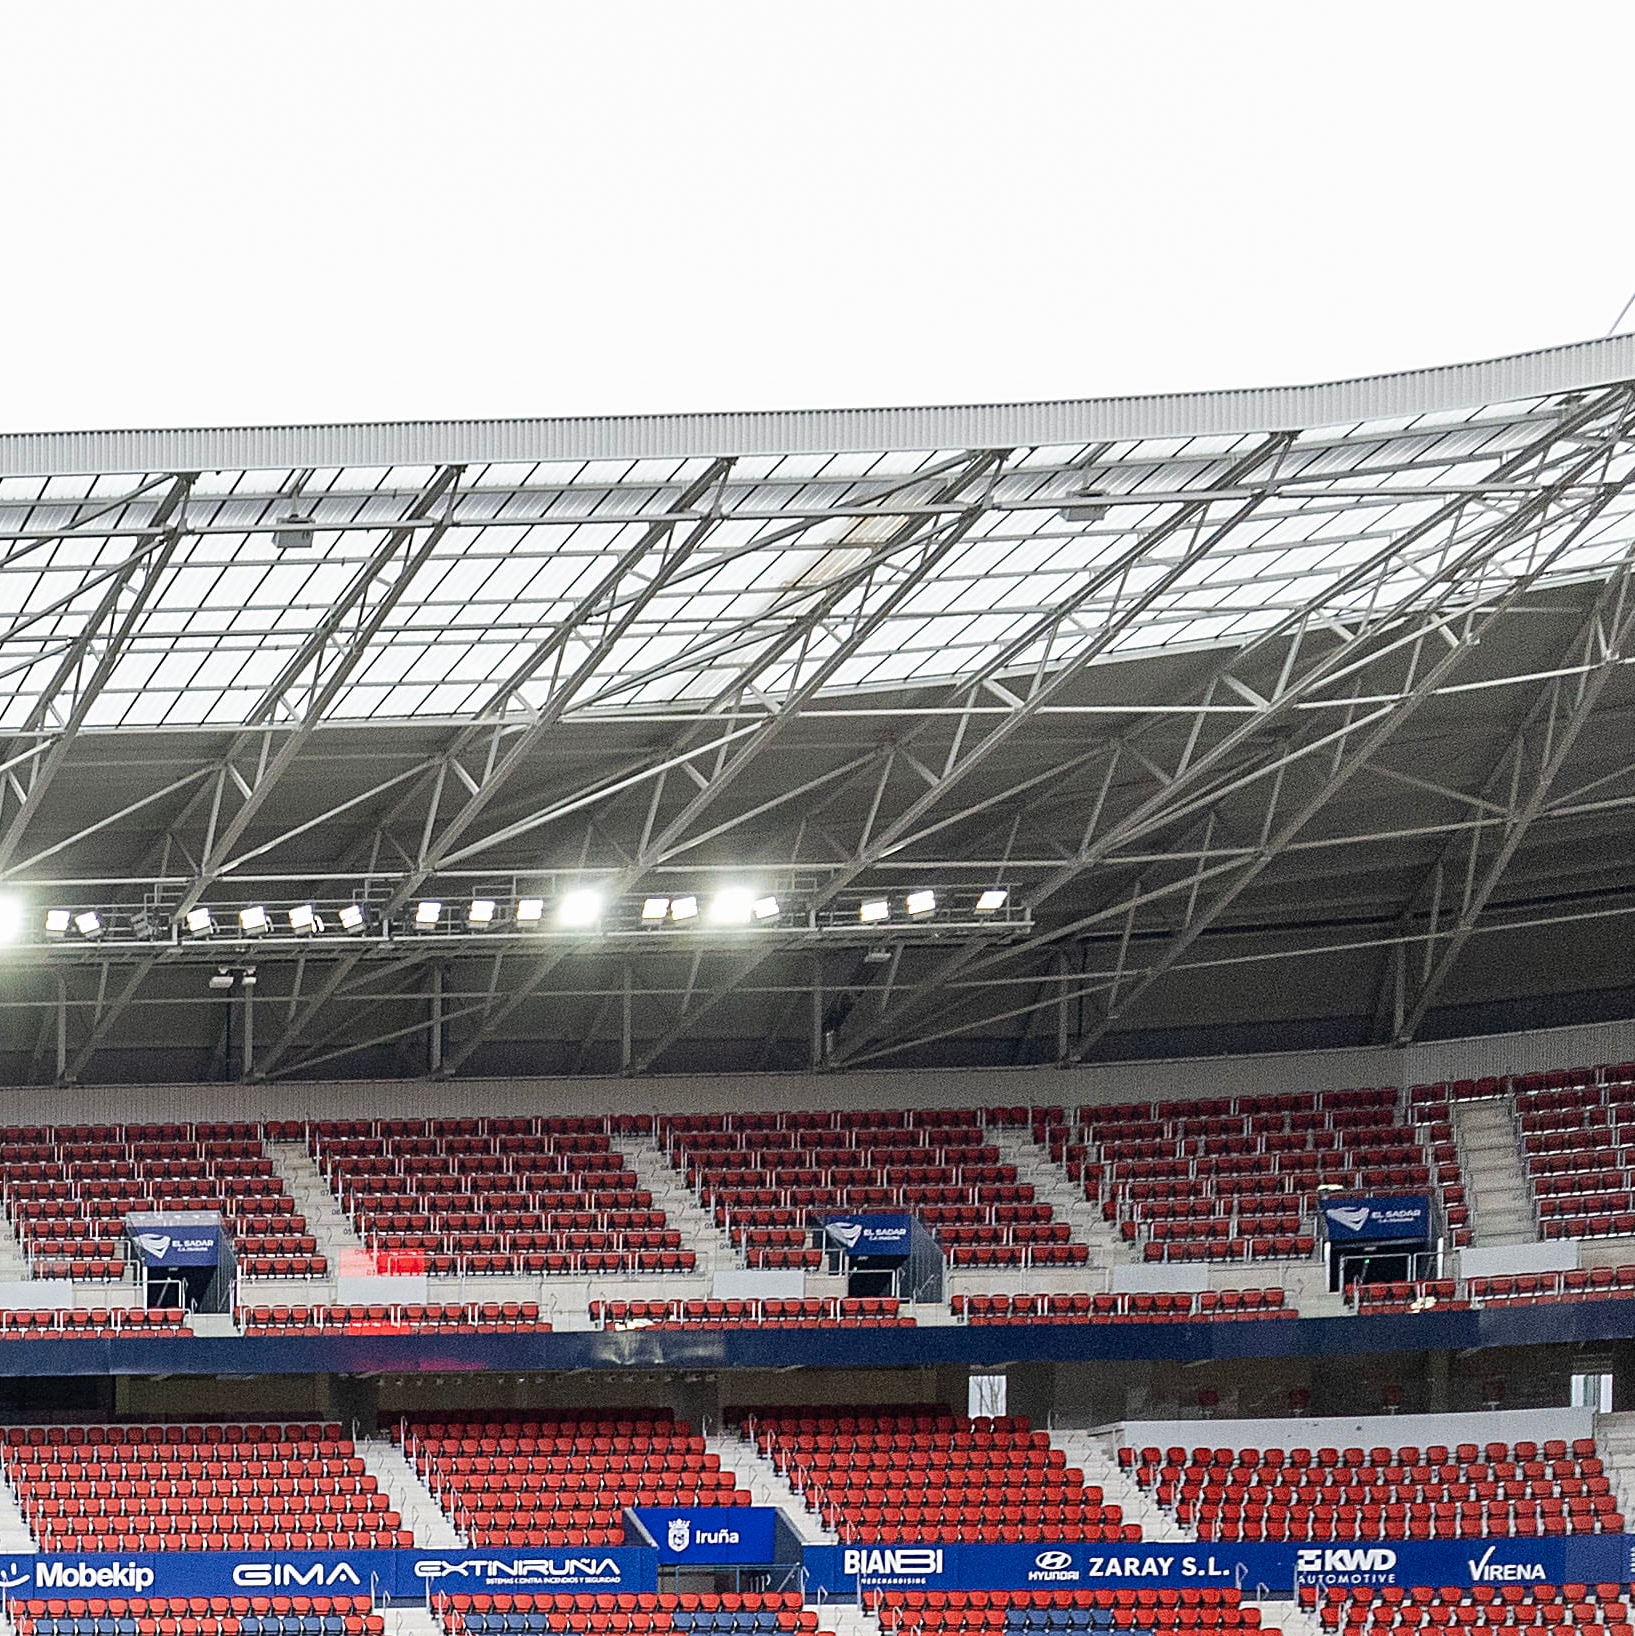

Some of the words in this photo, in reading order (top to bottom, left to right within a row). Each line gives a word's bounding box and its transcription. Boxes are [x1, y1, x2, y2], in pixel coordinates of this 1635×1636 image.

[695, 1529, 739, 1545] Iruña
[1088, 1557, 1174, 1577] ZARAY
[1181, 1557, 1231, 1577] S.L.
[1324, 1549, 1397, 1571] KWD
[35, 1562, 155, 1592] Mobekip
[232, 1563, 361, 1586] GIMA
[1028, 1571, 1080, 1581] HYUNDAI
[1297, 1573, 1396, 1584] AUTOMOTIVE
